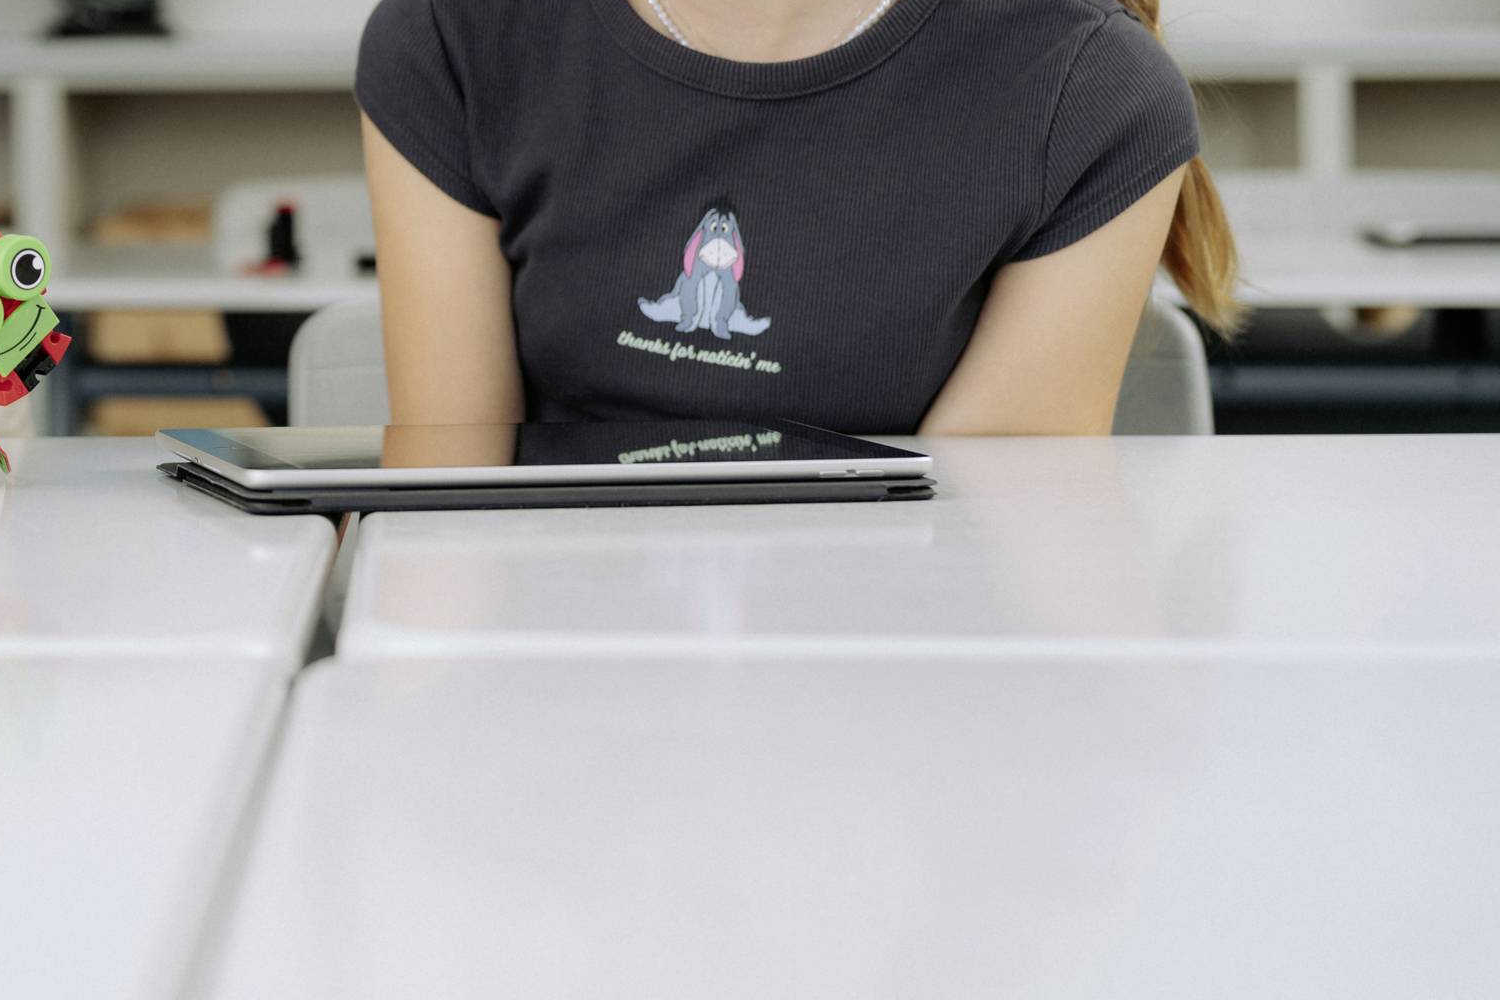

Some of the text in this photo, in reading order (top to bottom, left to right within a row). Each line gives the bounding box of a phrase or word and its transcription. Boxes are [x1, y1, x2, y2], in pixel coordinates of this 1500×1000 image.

[616, 330, 782, 374] thanks for noticin' me
